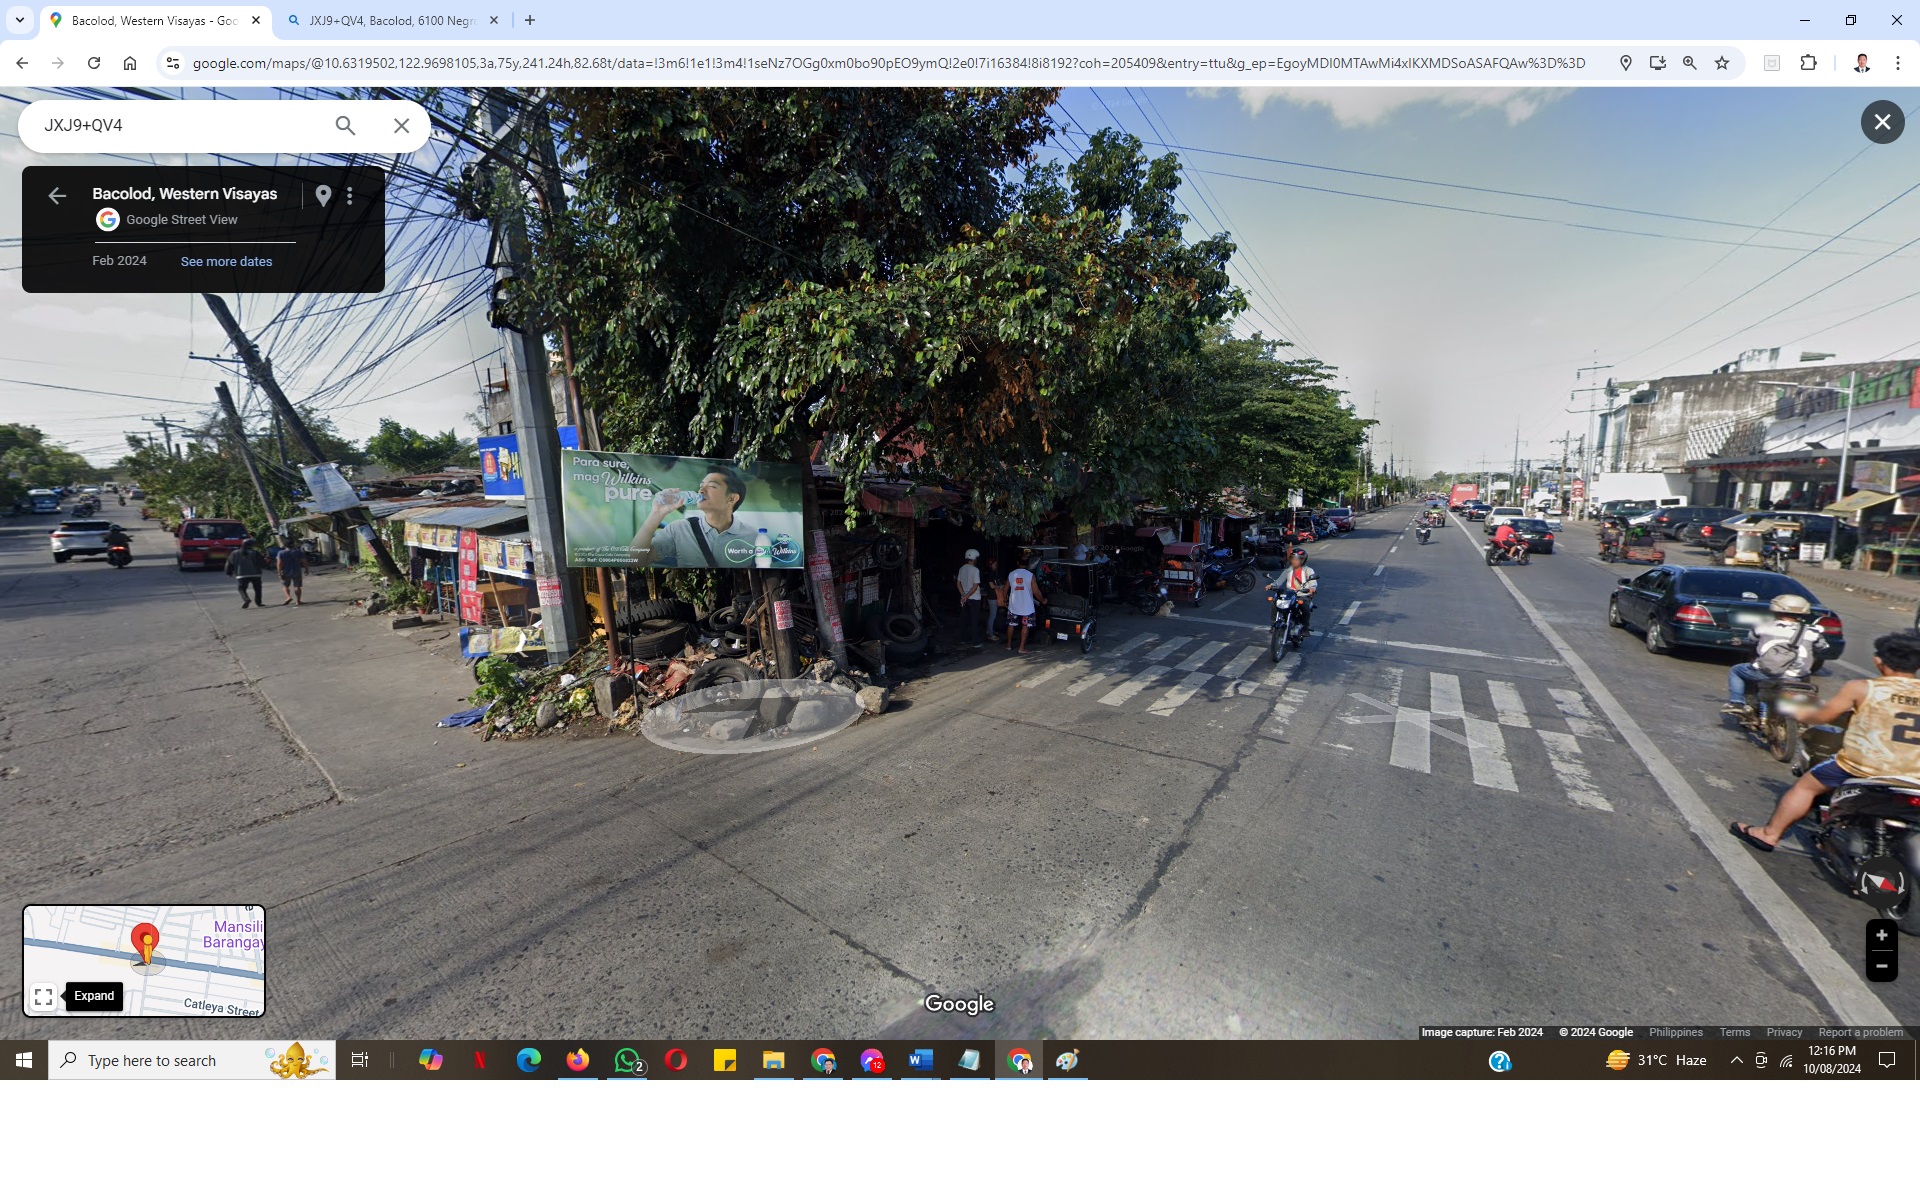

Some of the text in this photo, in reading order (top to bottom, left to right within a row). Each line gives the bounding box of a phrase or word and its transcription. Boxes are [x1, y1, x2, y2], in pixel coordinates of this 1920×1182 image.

[73, 16, 116, 27] Bacolod,
[121, 16, 163, 26] Western
[167, 16, 205, 28] Visayas
[310, 16, 365, 27] JXJ9+QV4,
[370, 16, 414, 27] Bacolod,
[418, 16, 444, 26] 6100
[45, 118, 123, 134] JXJ9+QV4
[93, 187, 278, 204] Bacolod, Western Visayas
[127, 213, 238, 227] Google Street View
[93, 255, 147, 266] Feb 2024
[181, 255, 273, 267] See more dates
[573, 456, 630, 470] Para sure,
[573, 469, 652, 486] mag Wilkins
[605, 486, 653, 502] pure
[1891, 694, 1920, 707] FERR
[215, 920, 263, 933] Mansili
[203, 936, 263, 951] Barangay
[75, 990, 114, 1003] Expand
[183, 998, 224, 1013] Catleya
[226, 1004, 260, 1016] Street
[925, 994, 995, 1017] Google
[1422, 1026, 1544, 1039] Image capture: Feb 2024
[1559, 1026, 1634, 1039] © 2024 Google
[1649, 1026, 1704, 1039] Philippines
[1720, 1026, 1751, 1037] Terms
[1767, 1026, 1802, 1039] Privacy
[1819, 1026, 1851, 1039] Report
[1861, 1026, 1904, 1039] problem
[1808, 1045, 1857, 1056] 12:16 PM
[88, 1054, 217, 1070] Type here to search
[1638, 1054, 1707, 1066] 31°C Haze
[1803, 1063, 1862, 1075] 10/08/2024
